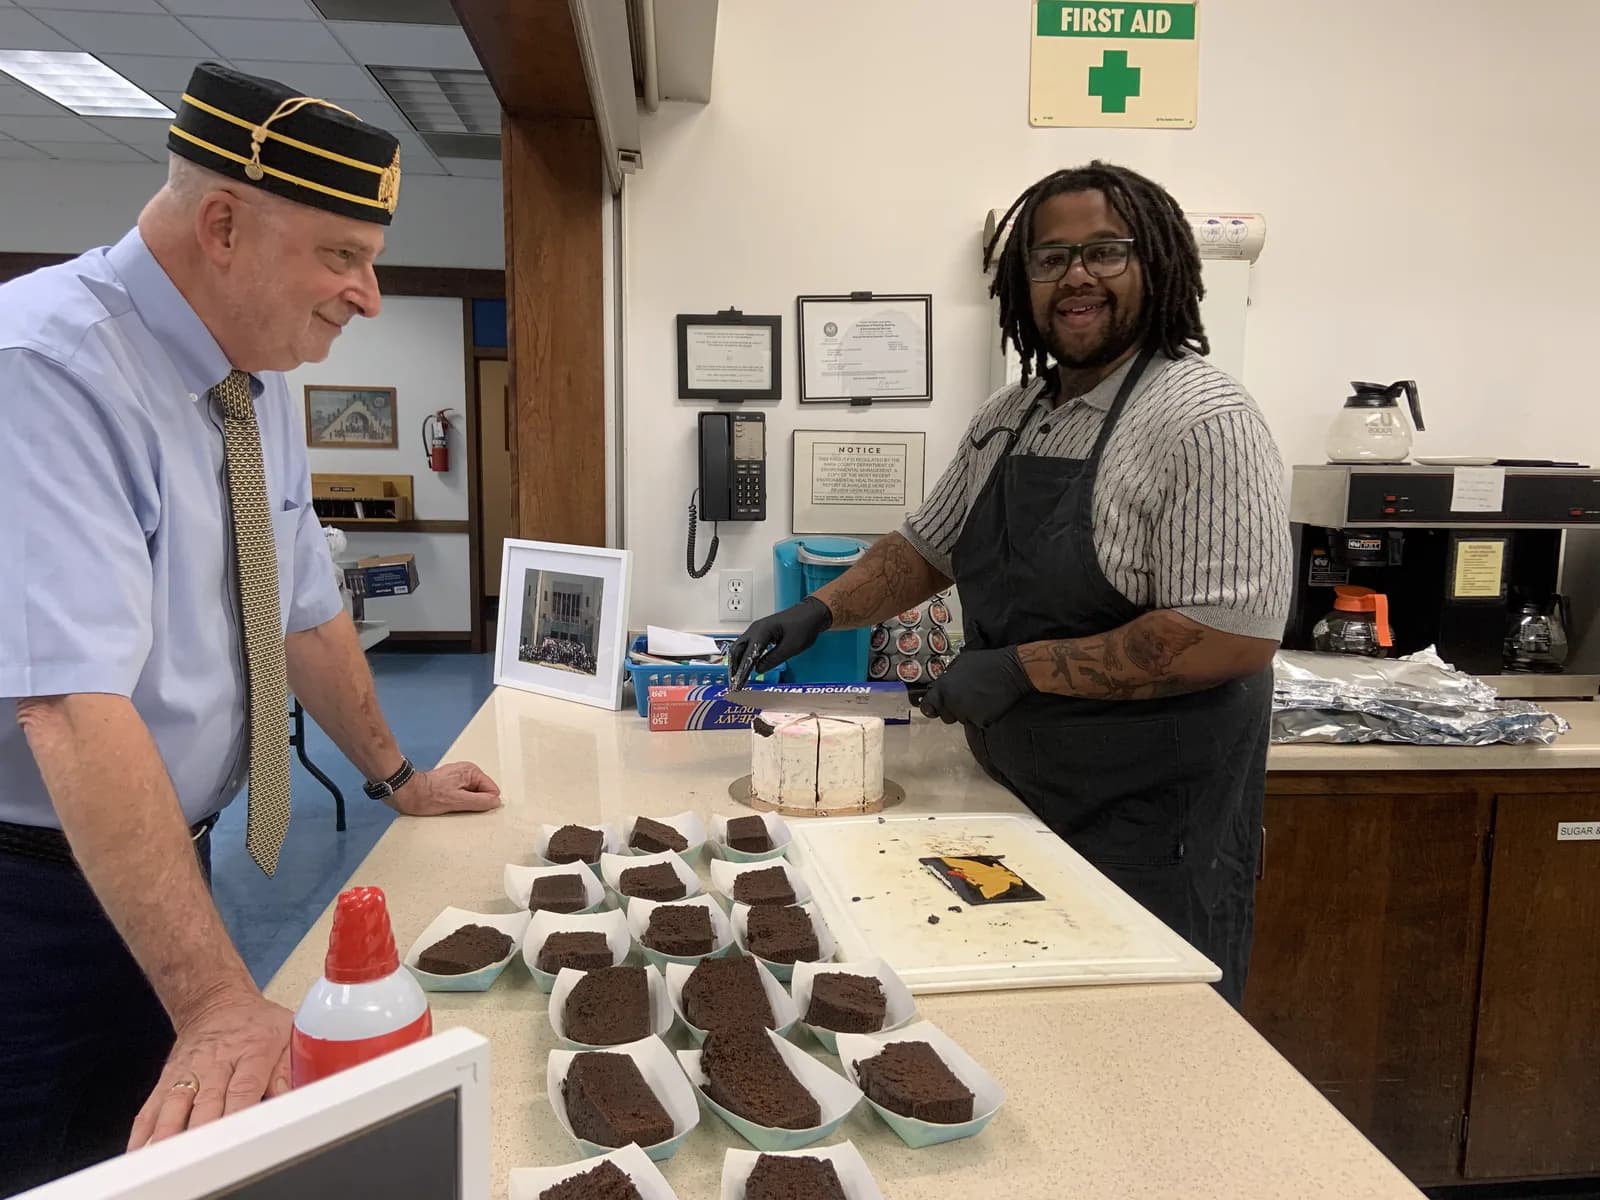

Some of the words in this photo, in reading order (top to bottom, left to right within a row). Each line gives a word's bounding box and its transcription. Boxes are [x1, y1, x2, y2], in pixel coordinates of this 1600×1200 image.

[1061, 7, 1125, 33] FIRST
[1130, 9, 1172, 34] AID
[805, 685, 872, 694] Reynolds
[724, 706, 755, 714] DUTY
[714, 713, 757, 724] HEAVY
[1560, 826, 1594, 835] SUGAR
